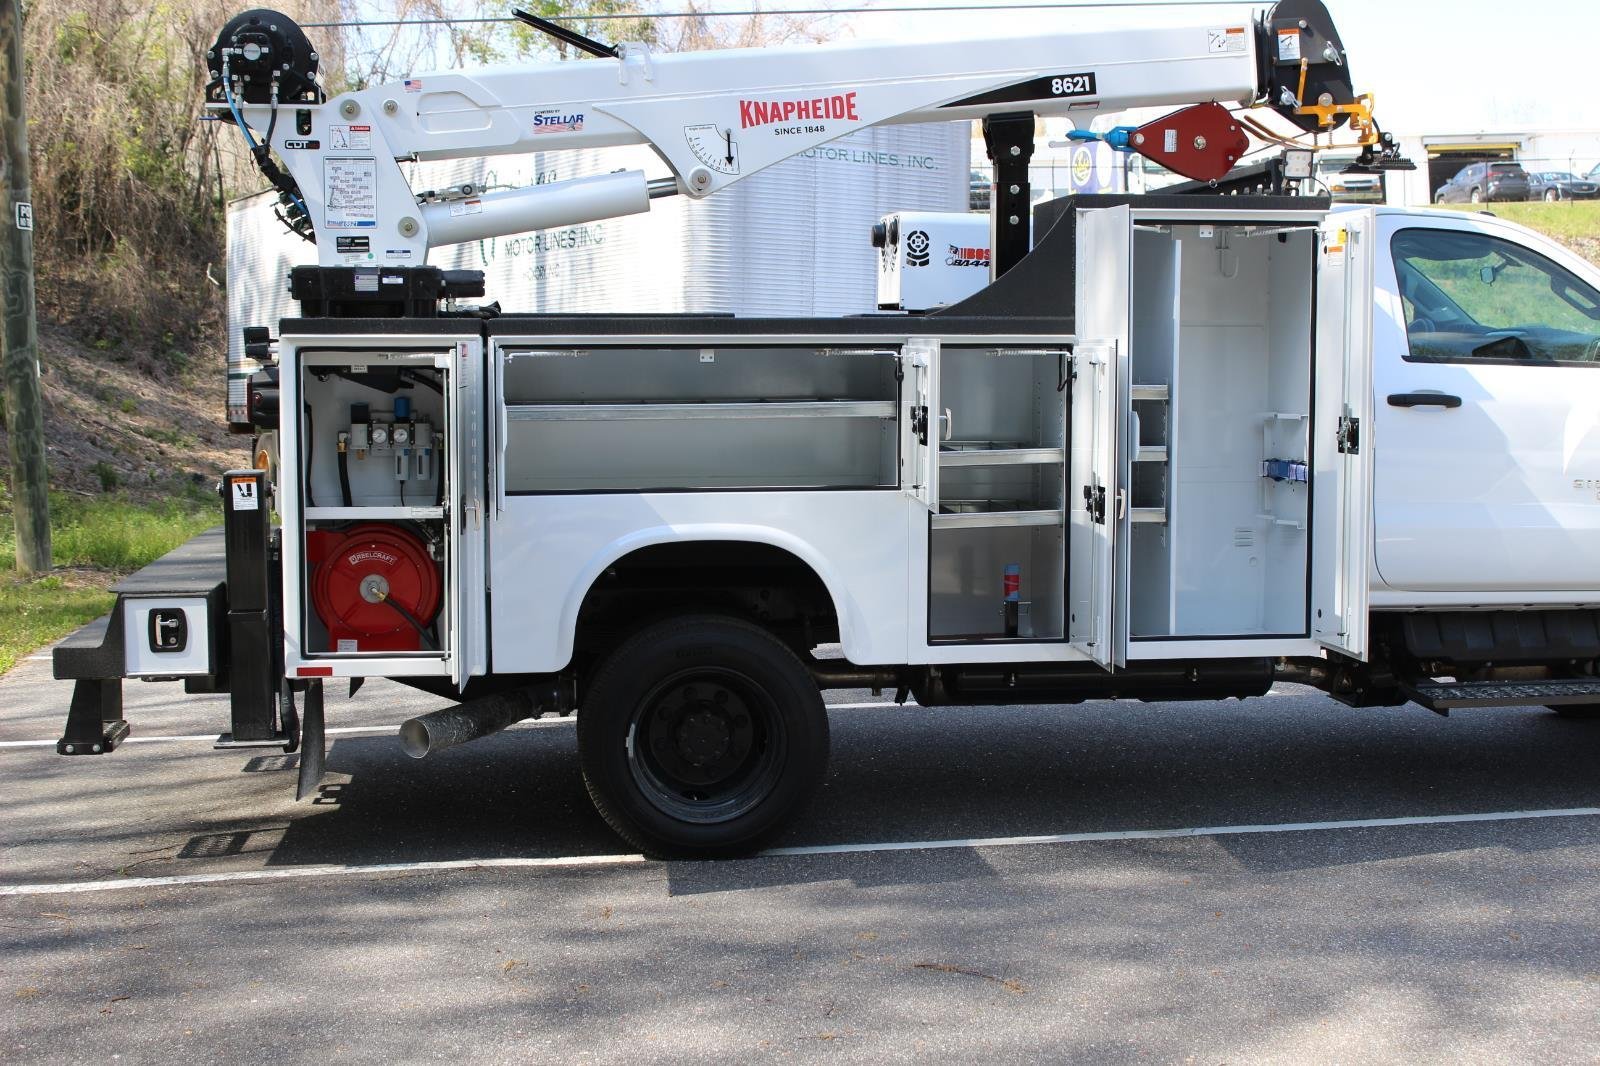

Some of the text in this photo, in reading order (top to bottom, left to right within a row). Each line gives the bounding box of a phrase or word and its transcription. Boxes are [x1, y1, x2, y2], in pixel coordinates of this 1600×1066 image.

[1051, 76, 1090, 94] 8621
[739, 92, 859, 129] KNAPHEIDE
[533, 114, 584, 126] STELLAR
[774, 125, 825, 135] SINCE 1848
[285, 140, 309, 149] CDT
[853, 151, 904, 167] LINES,
[908, 155, 939, 170] INC.
[505, 234, 542, 257] MOTOR
